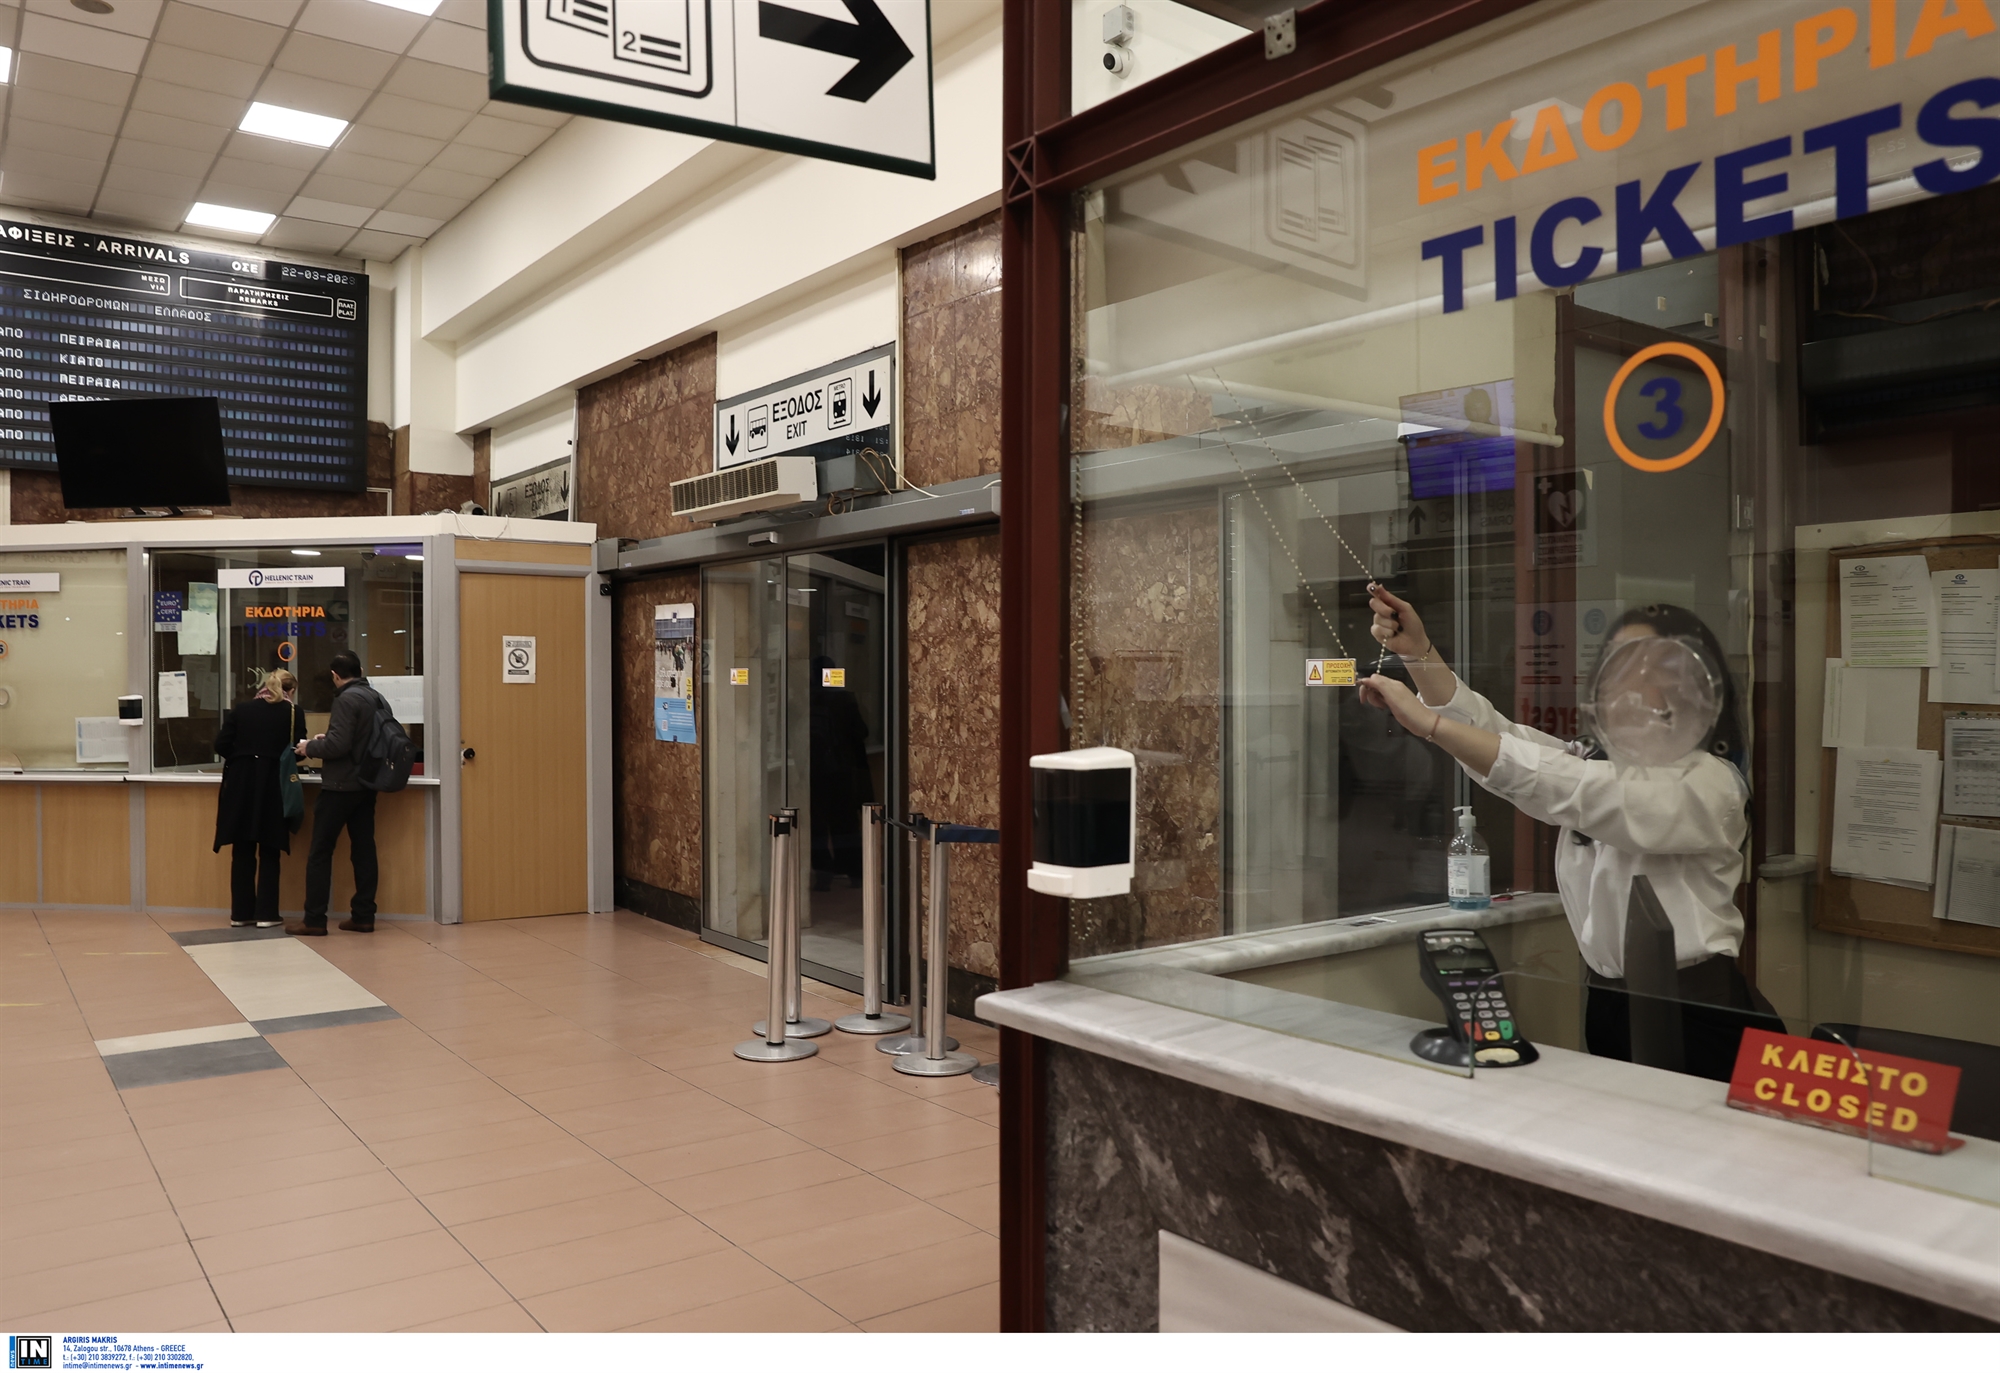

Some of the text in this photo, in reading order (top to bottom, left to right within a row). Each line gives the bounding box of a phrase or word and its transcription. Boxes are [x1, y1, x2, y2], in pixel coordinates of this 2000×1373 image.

[622, 31, 637, 52] 2
[1417, 0, 1997, 205] ΕΚΔΟΤΗΡΙΑ
[1421, 77, 2000, 314] TICKETS
[97, 240, 190, 264] ARRIVALS
[231, 261, 259, 274] ΟΣΕ
[150, 283, 166, 291] VIA
[24, 288, 130, 312] ΣΙΔΗΡΟΔΡΟΜΩΝ
[239, 295, 279, 307] REMARKS
[60, 333, 121, 350] ΠΕΙΡΑΙΑ
[60, 353, 104, 368] ΚΙΑΤΟ
[772, 389, 823, 423] ΕΞΟΔΟΣ
[1637, 377, 1684, 439] 3
[786, 420, 808, 440] EXIT
[245, 606, 326, 618] ΕΚΔΟΤΗΡΙΑ
[244, 621, 327, 637] TICKETS
[1760, 1043, 1928, 1097] ΚΛΕΙΣΤΟ
[1754, 1077, 1919, 1133] CLOSED
